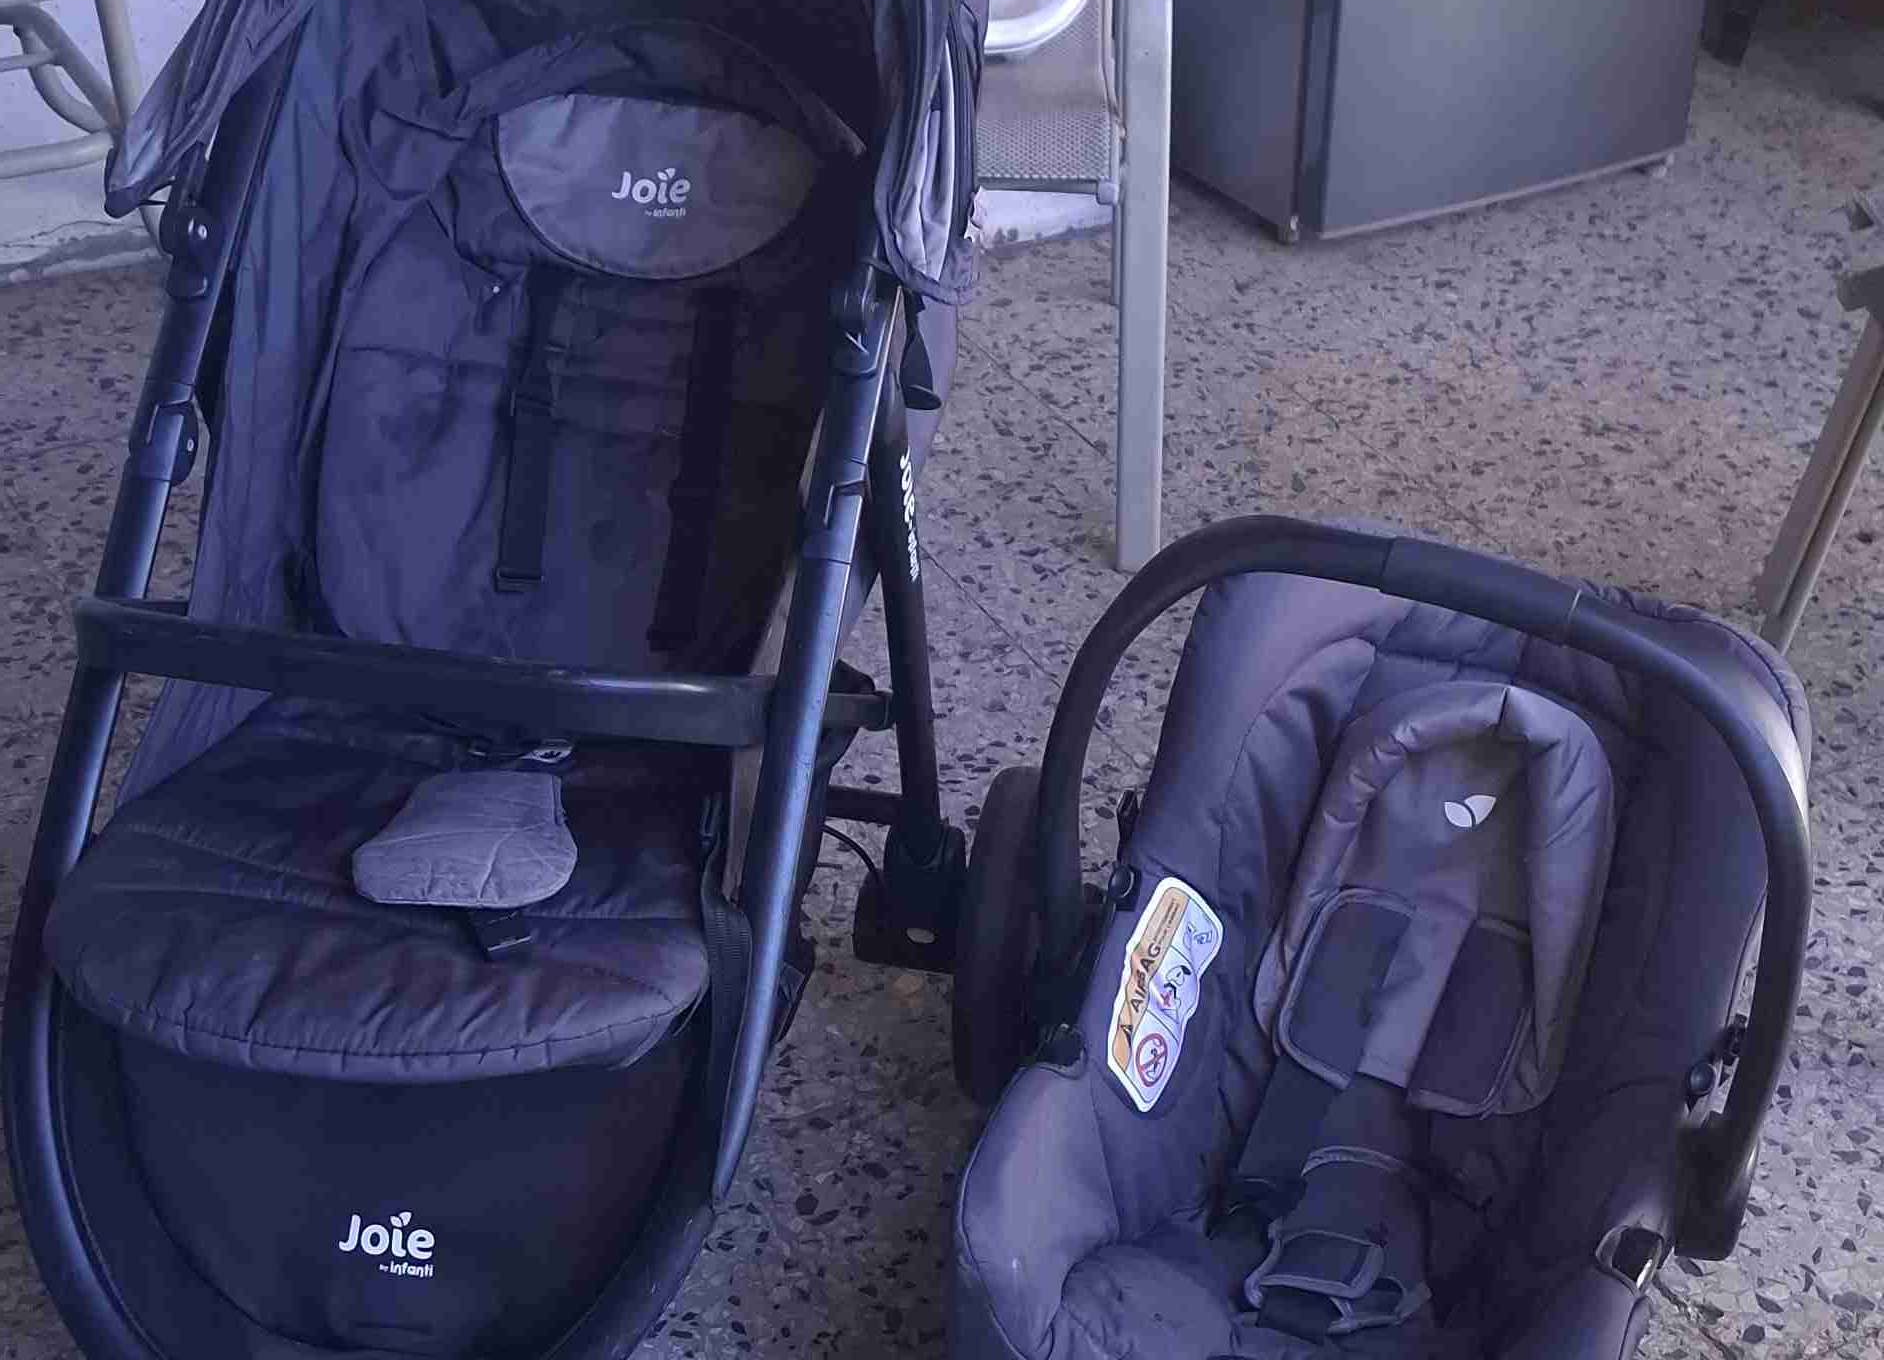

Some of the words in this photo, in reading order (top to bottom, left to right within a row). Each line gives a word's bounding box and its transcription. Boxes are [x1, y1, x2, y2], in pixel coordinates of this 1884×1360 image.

[611, 167, 691, 204] Joie
[338, 1210, 436, 1261] Joie
[389, 1260, 434, 1279] infanti
